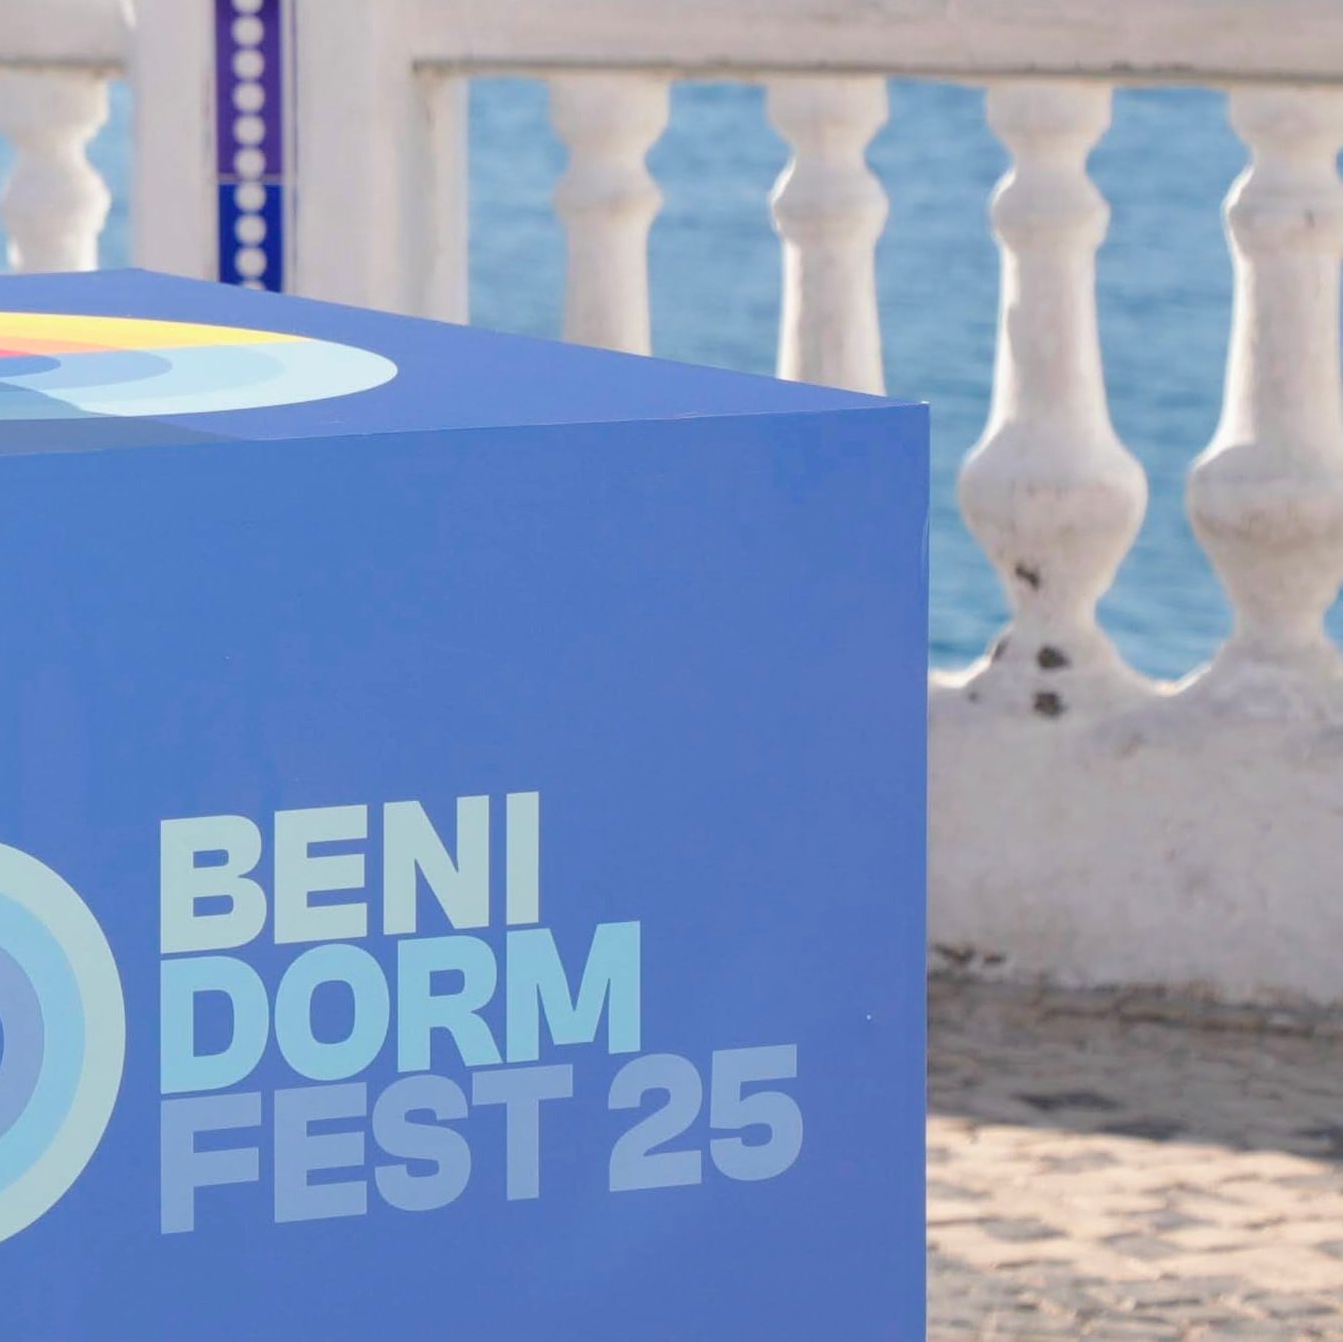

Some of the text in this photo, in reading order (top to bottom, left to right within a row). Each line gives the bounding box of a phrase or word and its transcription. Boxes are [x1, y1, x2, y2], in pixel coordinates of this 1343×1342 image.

[160, 791, 540, 954] BENI
[160, 920, 641, 1095] DORM
[160, 1044, 804, 1235] FEST 25
